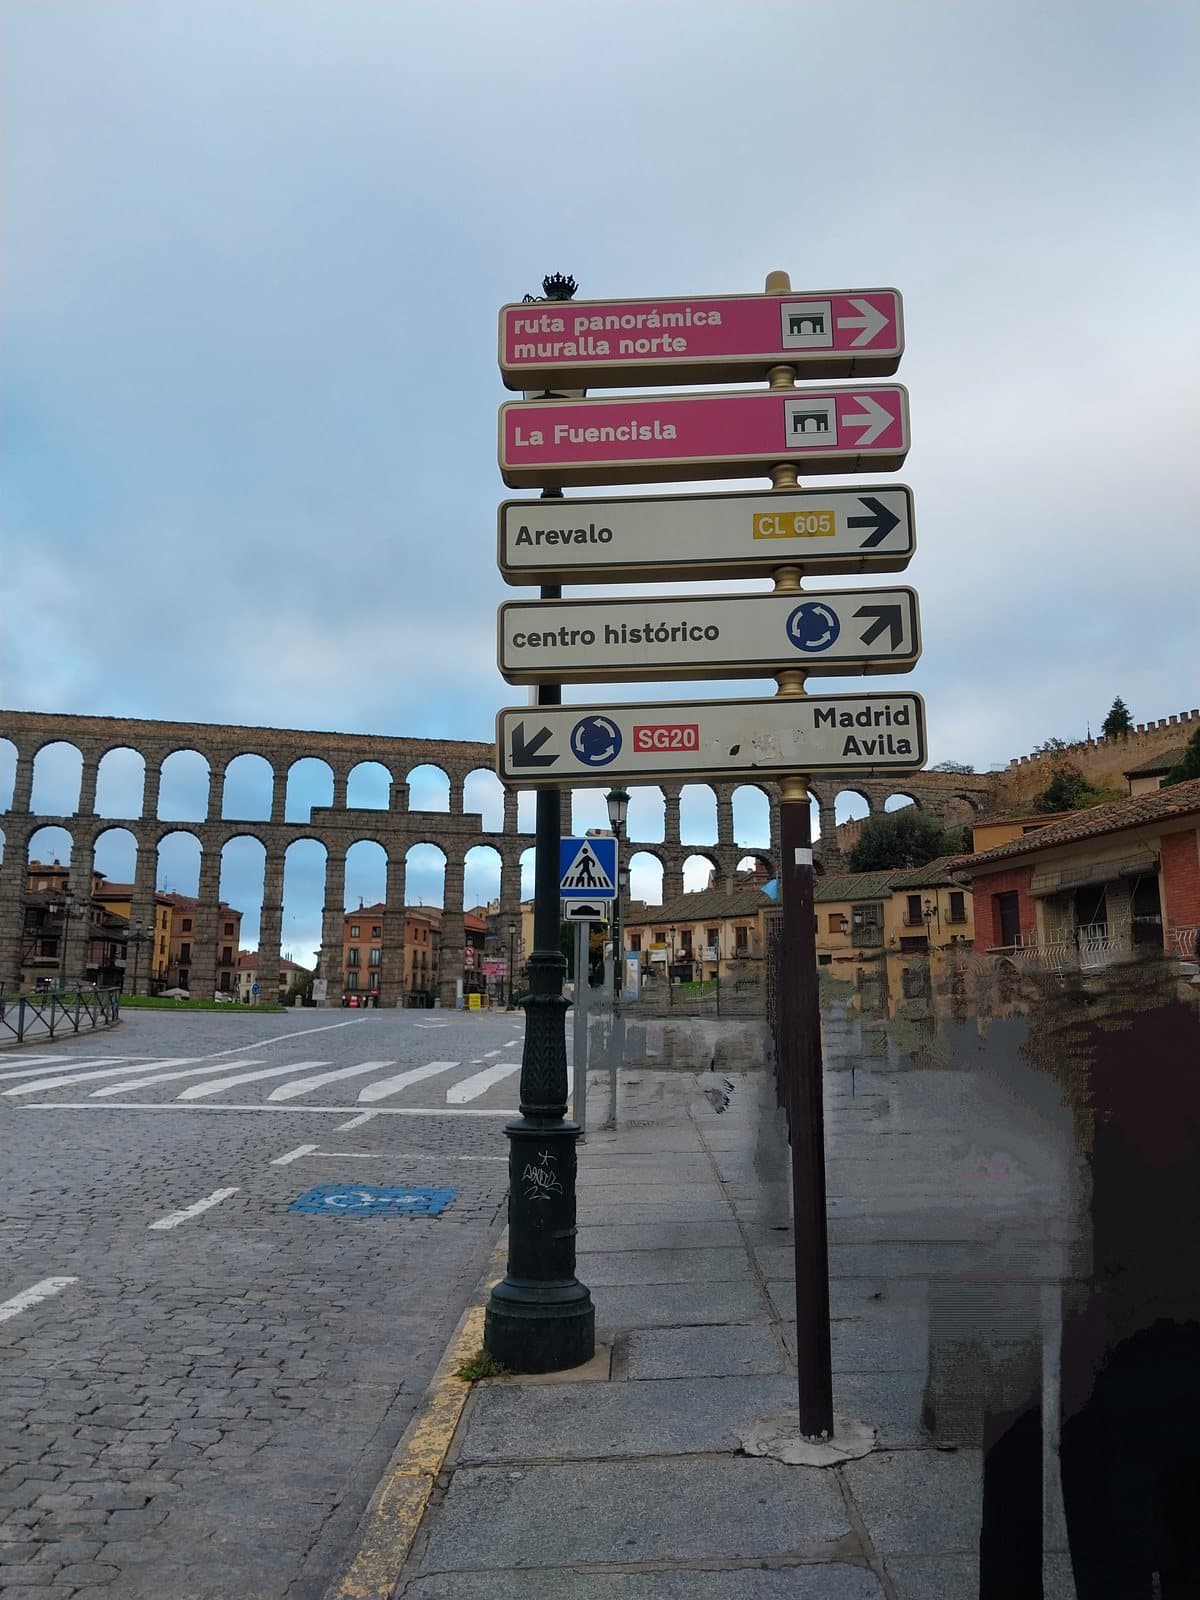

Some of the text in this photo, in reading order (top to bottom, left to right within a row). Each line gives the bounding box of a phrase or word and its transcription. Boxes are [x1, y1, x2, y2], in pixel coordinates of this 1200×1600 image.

[514, 307, 721, 334] ruta panorámica
[514, 333, 688, 358] muralla norte
[514, 420, 677, 447] La Fuencisla
[515, 524, 613, 546] Arevalo
[758, 515, 831, 536] CL 605
[512, 622, 720, 648] centro histórico
[813, 705, 910, 728] Madrid
[638, 728, 696, 748] SG20
[842, 735, 912, 757] Avila
